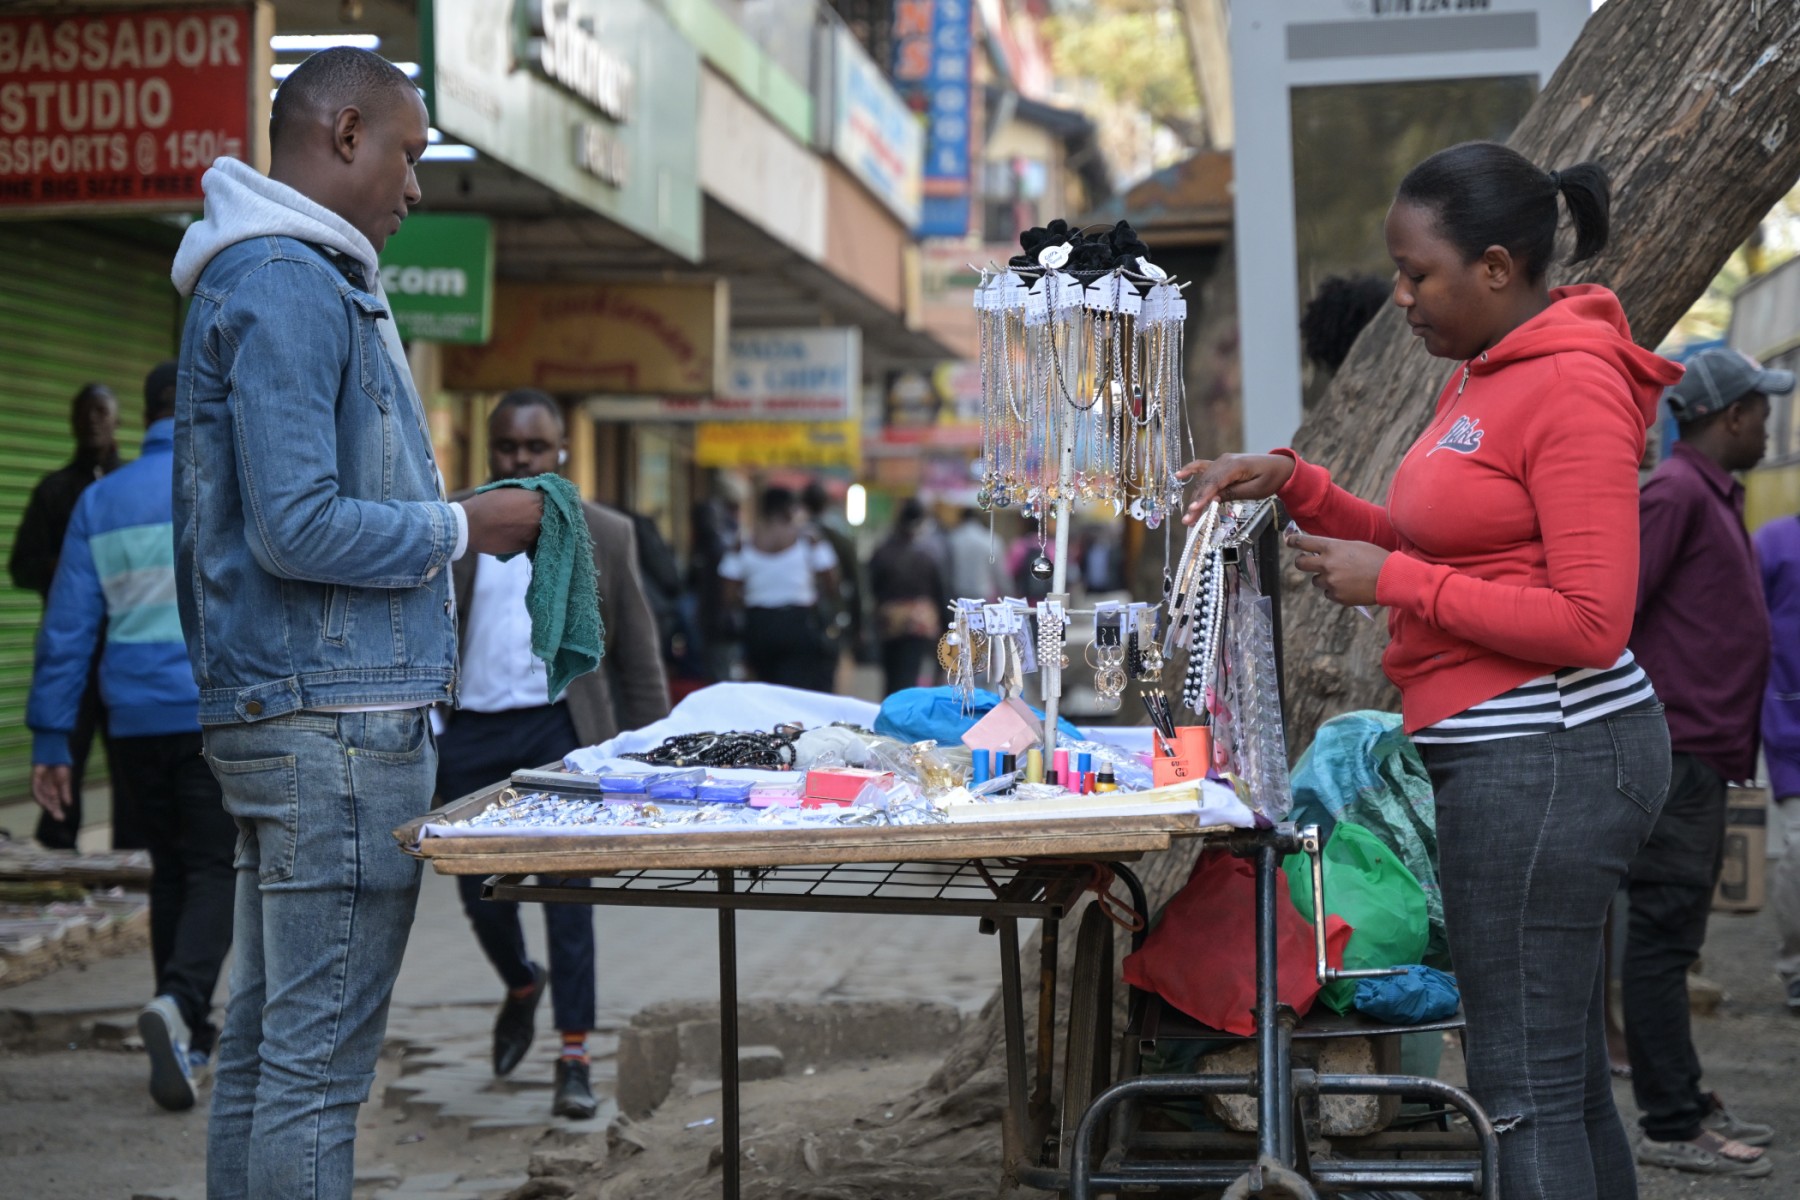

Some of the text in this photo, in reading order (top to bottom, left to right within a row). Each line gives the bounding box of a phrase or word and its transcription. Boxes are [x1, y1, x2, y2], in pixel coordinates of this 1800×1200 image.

[0, 16, 241, 73] BASSADOR
[0, 77, 172, 133] STUDIO
[135, 132, 157, 174] @
[86, 174, 134, 198] SIZE
[142, 172, 196, 194] FREE
